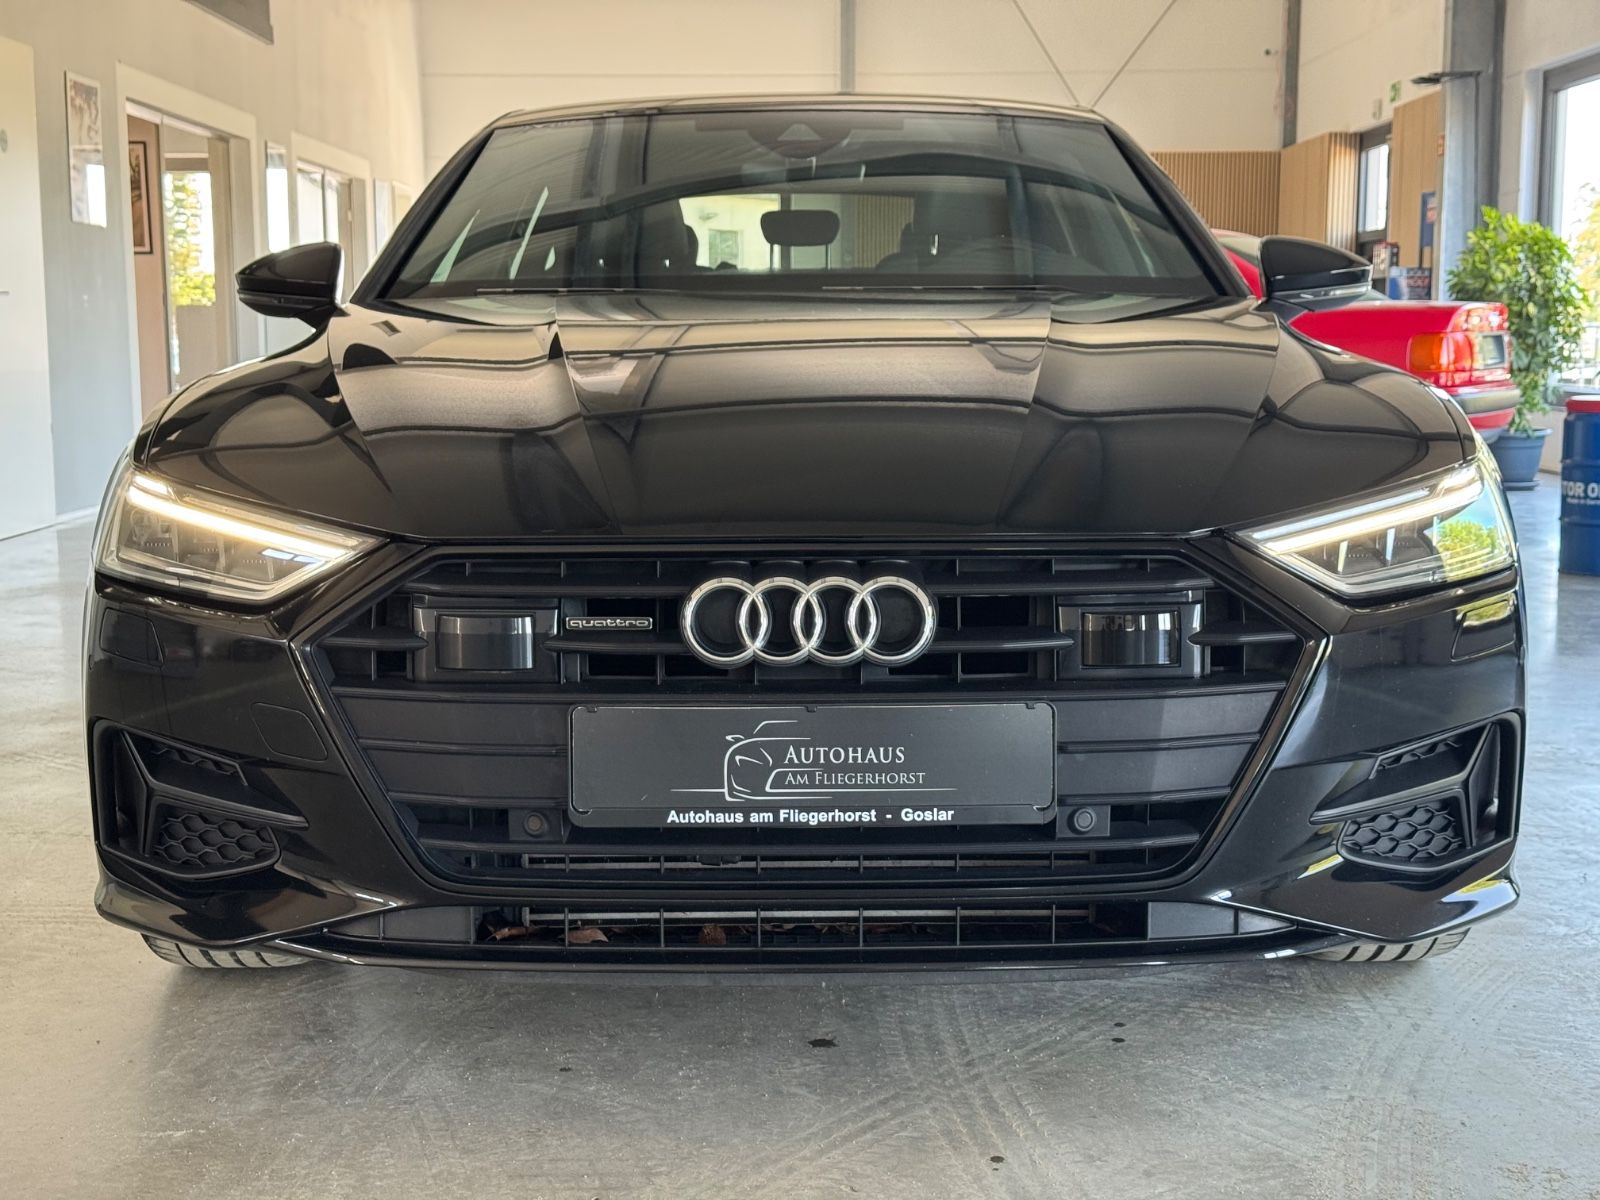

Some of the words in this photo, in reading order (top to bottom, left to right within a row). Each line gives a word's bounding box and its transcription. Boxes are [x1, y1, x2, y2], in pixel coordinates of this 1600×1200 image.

[570, 619, 649, 629] quattro
[784, 745, 905, 764] AUTOHAUS
[784, 772, 809, 785] AM
[815, 771, 926, 785] FLIEGERHORST
[667, 810, 744, 823] Autohaus
[750, 814, 773, 823] am
[779, 808, 877, 826] Fliegerhorst
[901, 807, 955, 822] Goslar
